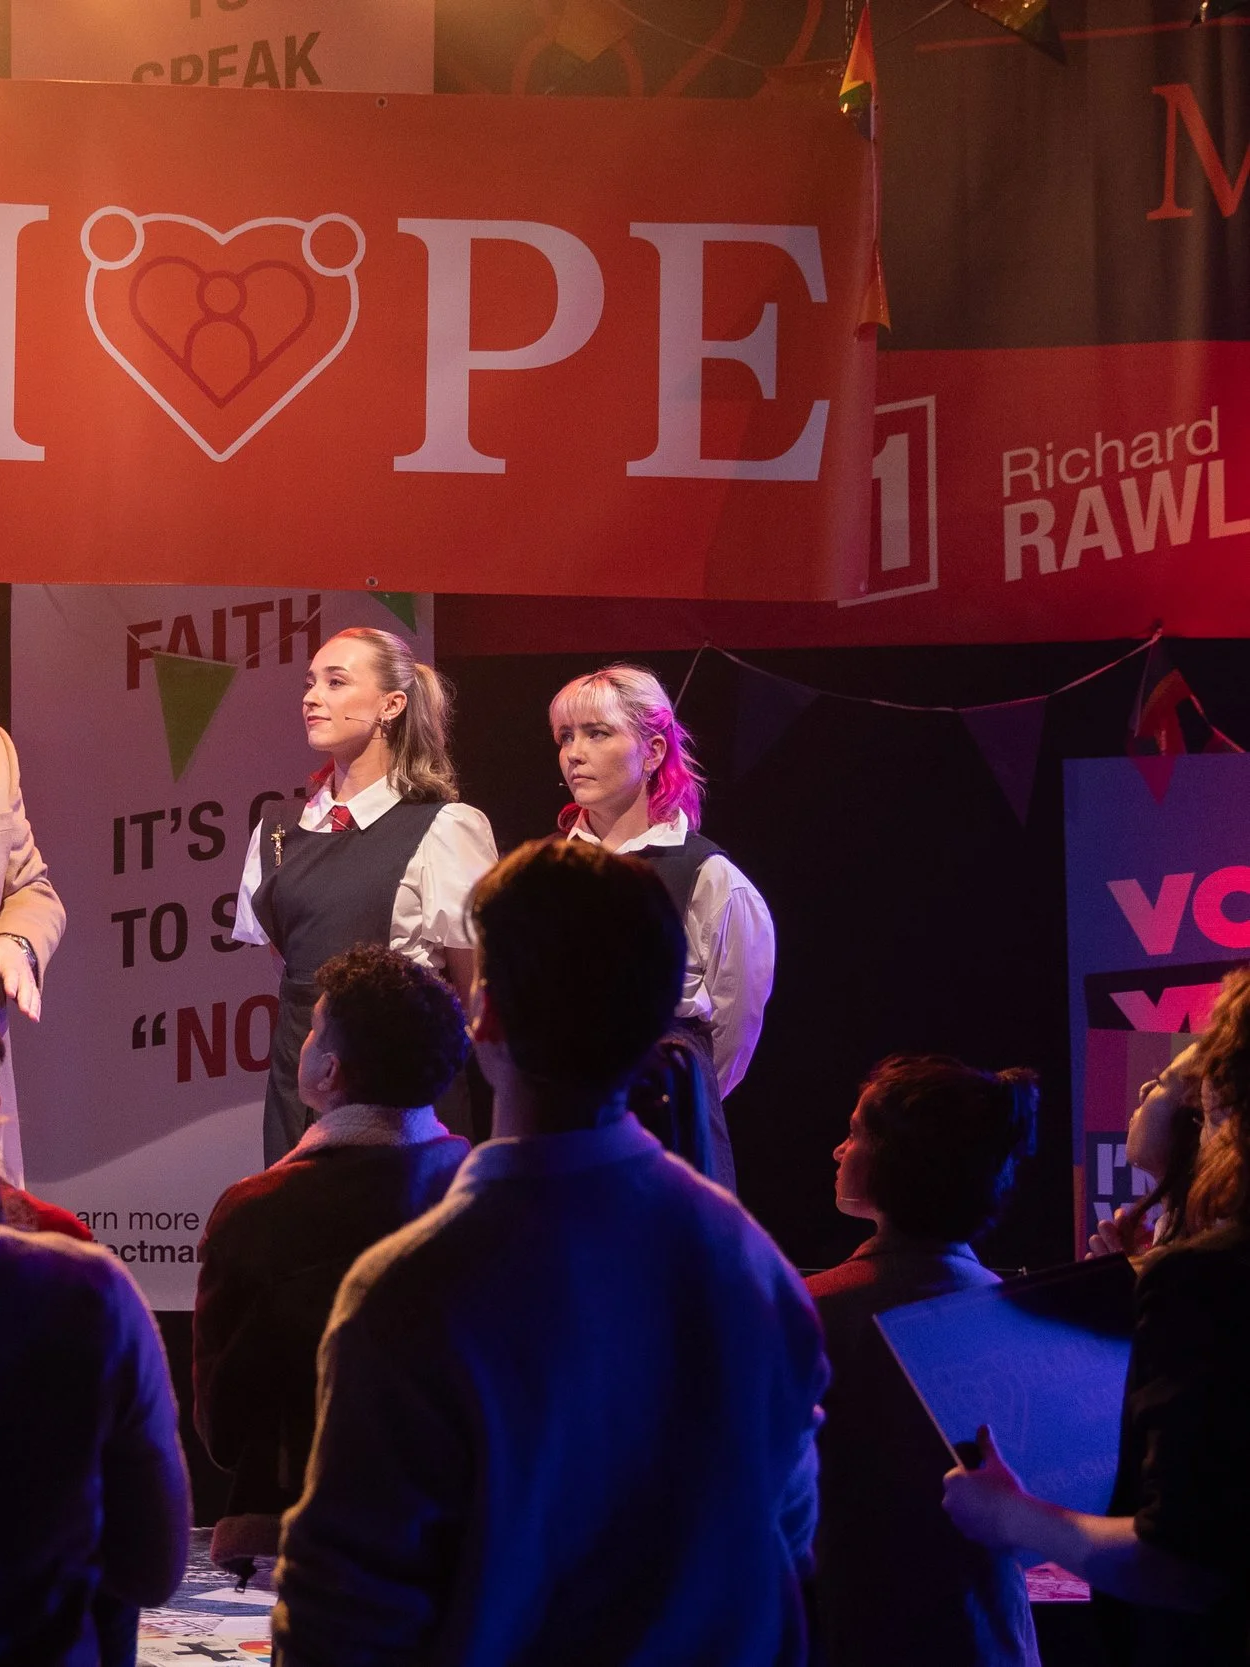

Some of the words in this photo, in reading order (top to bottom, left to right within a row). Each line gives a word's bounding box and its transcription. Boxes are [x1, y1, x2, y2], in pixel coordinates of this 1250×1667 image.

[1002, 405, 1221, 497] Richard
[113, 800, 226, 875] IT’S
[111, 902, 189, 969] TO
[129, 1211, 200, 1231] more
